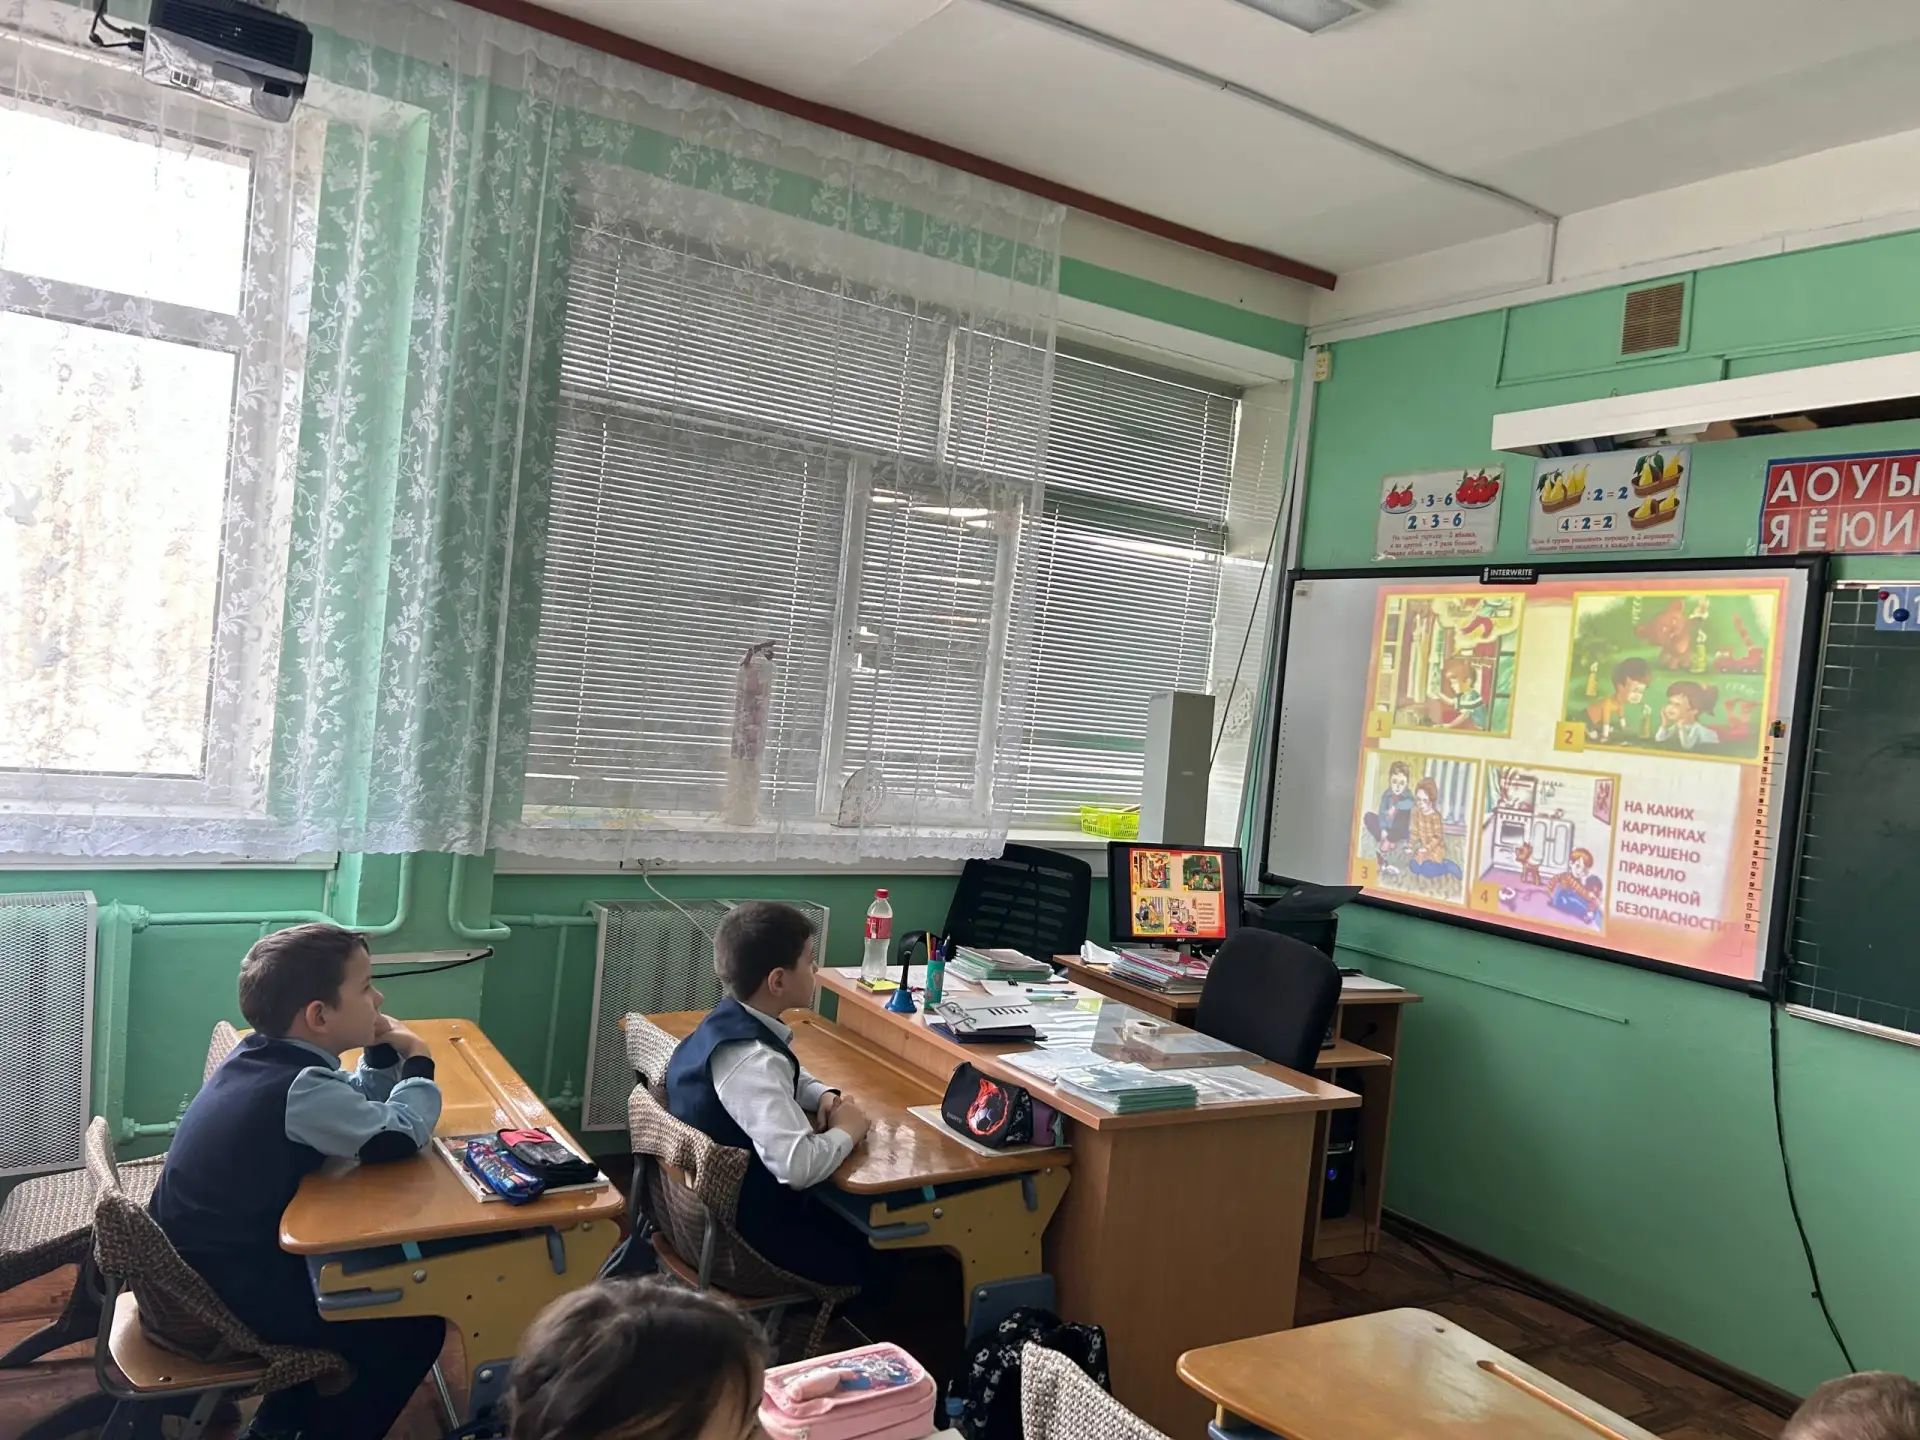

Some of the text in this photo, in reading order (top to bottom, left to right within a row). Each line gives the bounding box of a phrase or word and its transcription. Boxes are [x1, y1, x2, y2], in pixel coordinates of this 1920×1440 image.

[1593, 488, 1603, 501] 2
[1617, 487, 1628, 499] 2
[1769, 470, 1798, 504] А
[1806, 466, 1840, 502] О
[1851, 463, 1880, 499] У
[1426, 494, 1435, 507] 3
[1444, 493, 1453, 506] 6
[1407, 515, 1417, 529] 2
[1431, 514, 1440, 528] 3
[1453, 513, 1462, 527] 6
[1561, 518, 1570, 531] 4
[1581, 517, 1591, 529] 2
[1602, 516, 1613, 528] 2
[1768, 508, 1914, 548] Я Ё Ю И
[1490, 568, 1533, 576] INTERWRITE
[1624, 800, 1695, 820] НА КАКИХ
[1622, 820, 1706, 843] КАРТИНКАХ
[1620, 840, 1701, 863] НАРУШЕНО
[1619, 860, 1686, 882] ПРАВИЛО
[1617, 880, 1701, 907] ПОЖАРНОЙ
